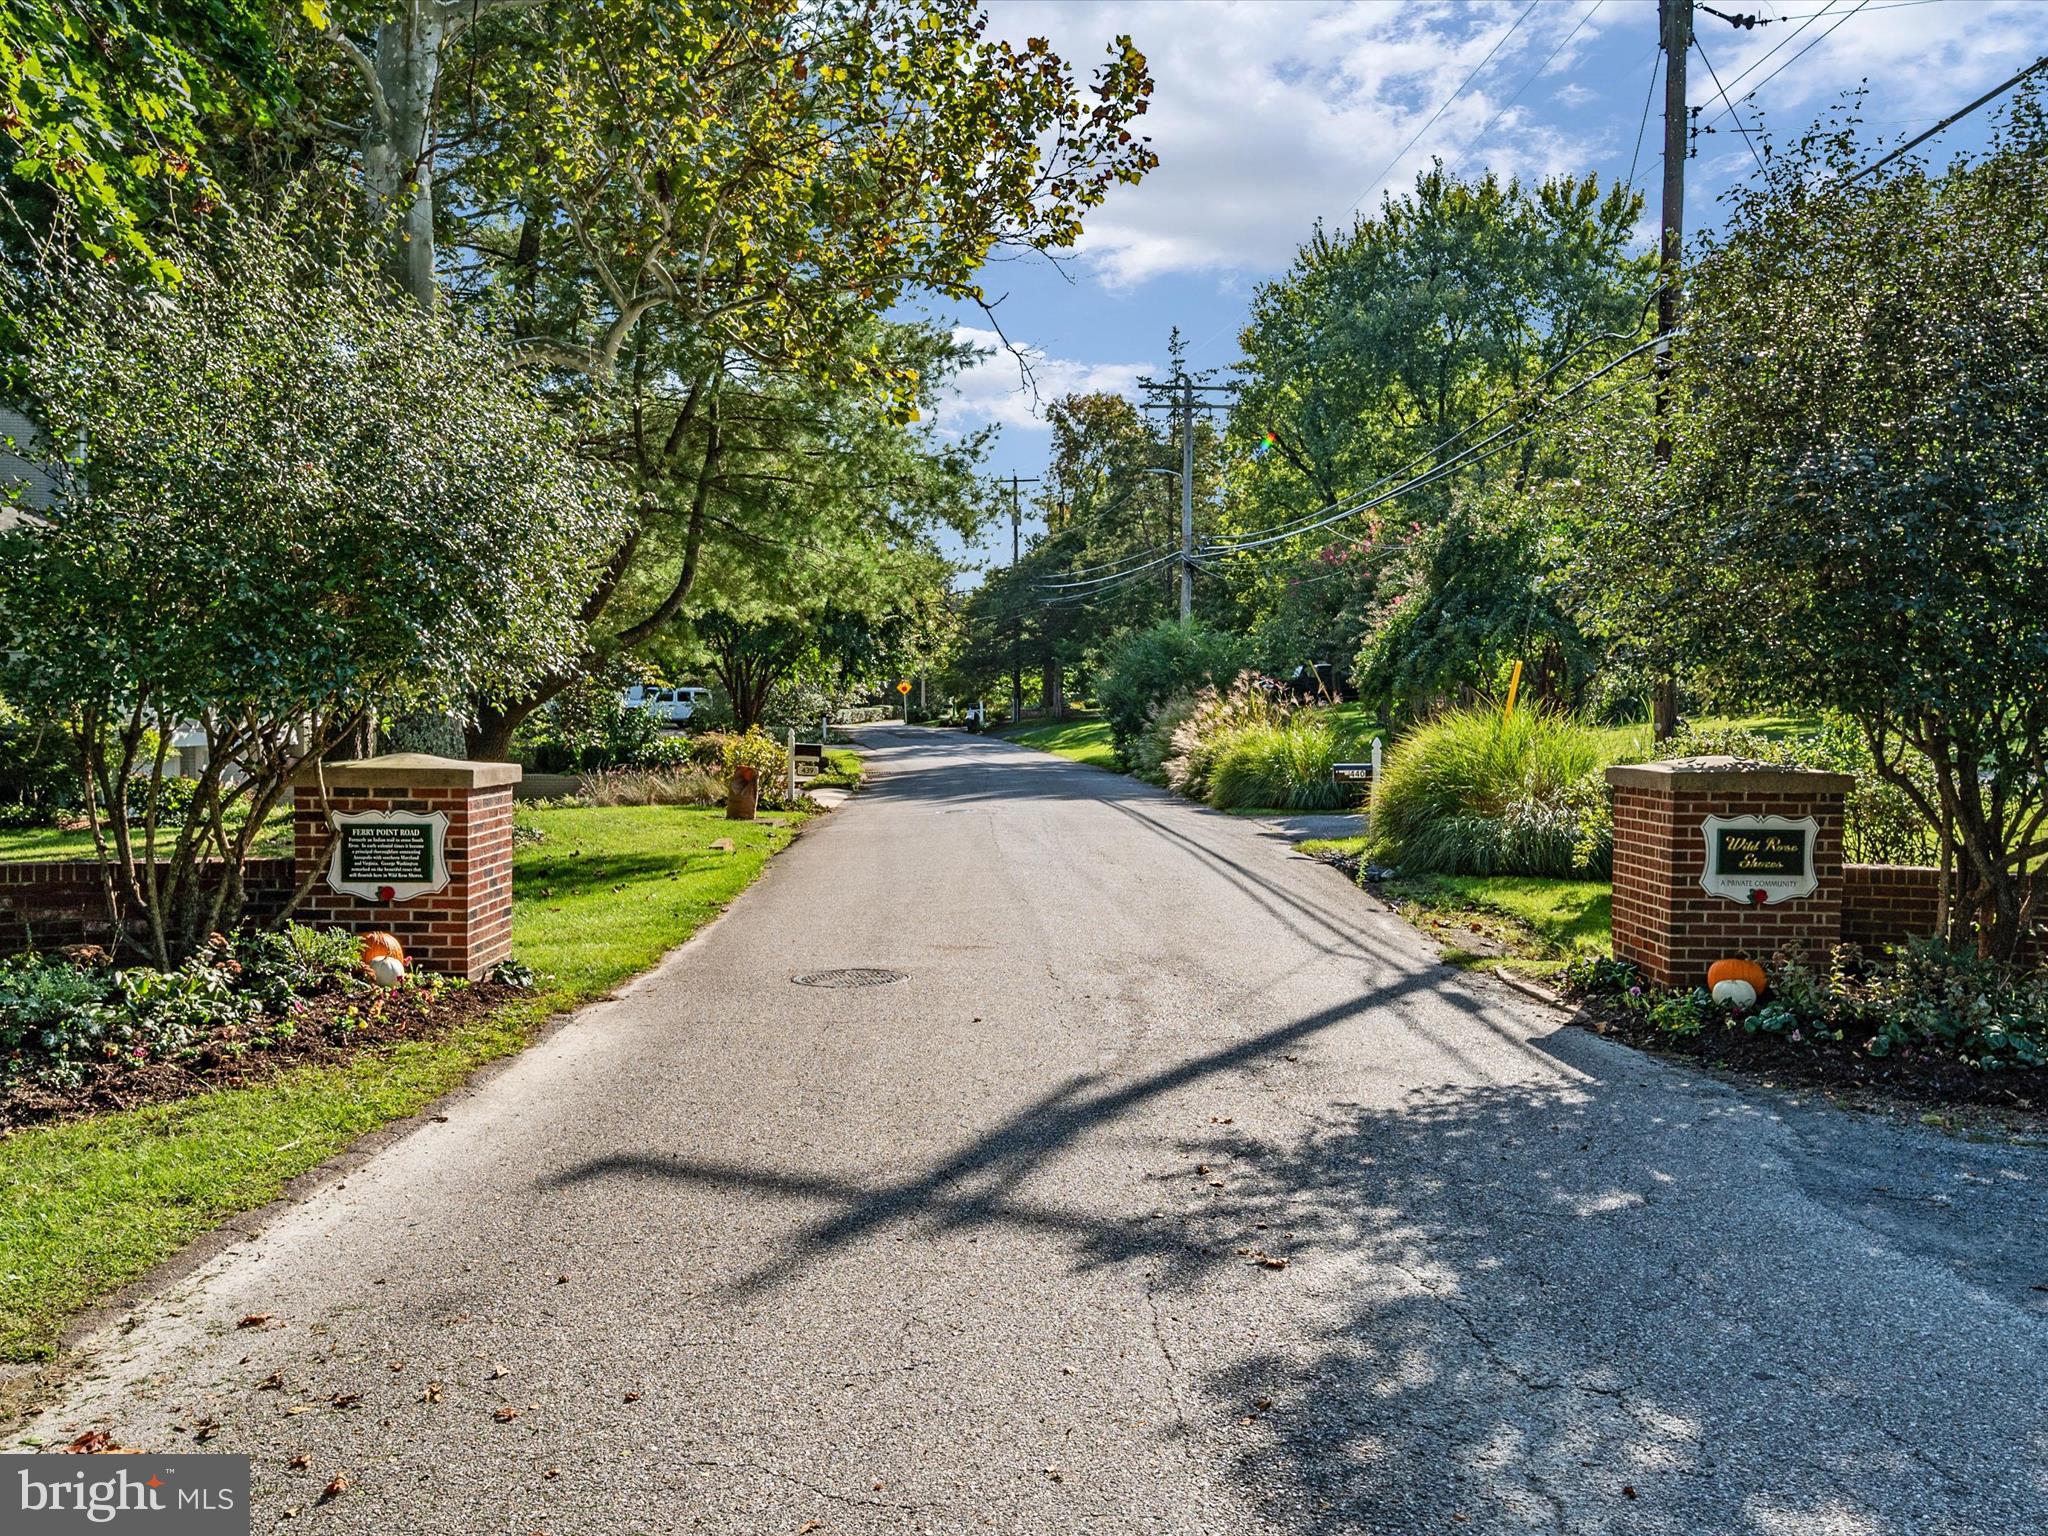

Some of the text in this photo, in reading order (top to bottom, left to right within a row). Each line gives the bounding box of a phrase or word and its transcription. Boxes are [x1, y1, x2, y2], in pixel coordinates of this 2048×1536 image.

[1350, 770, 1365, 778] 440
[352, 828, 420, 836] FERRY POINT ROAD
[1725, 835, 1799, 852] Wild Rose
[1738, 853, 1784, 869] Shores
